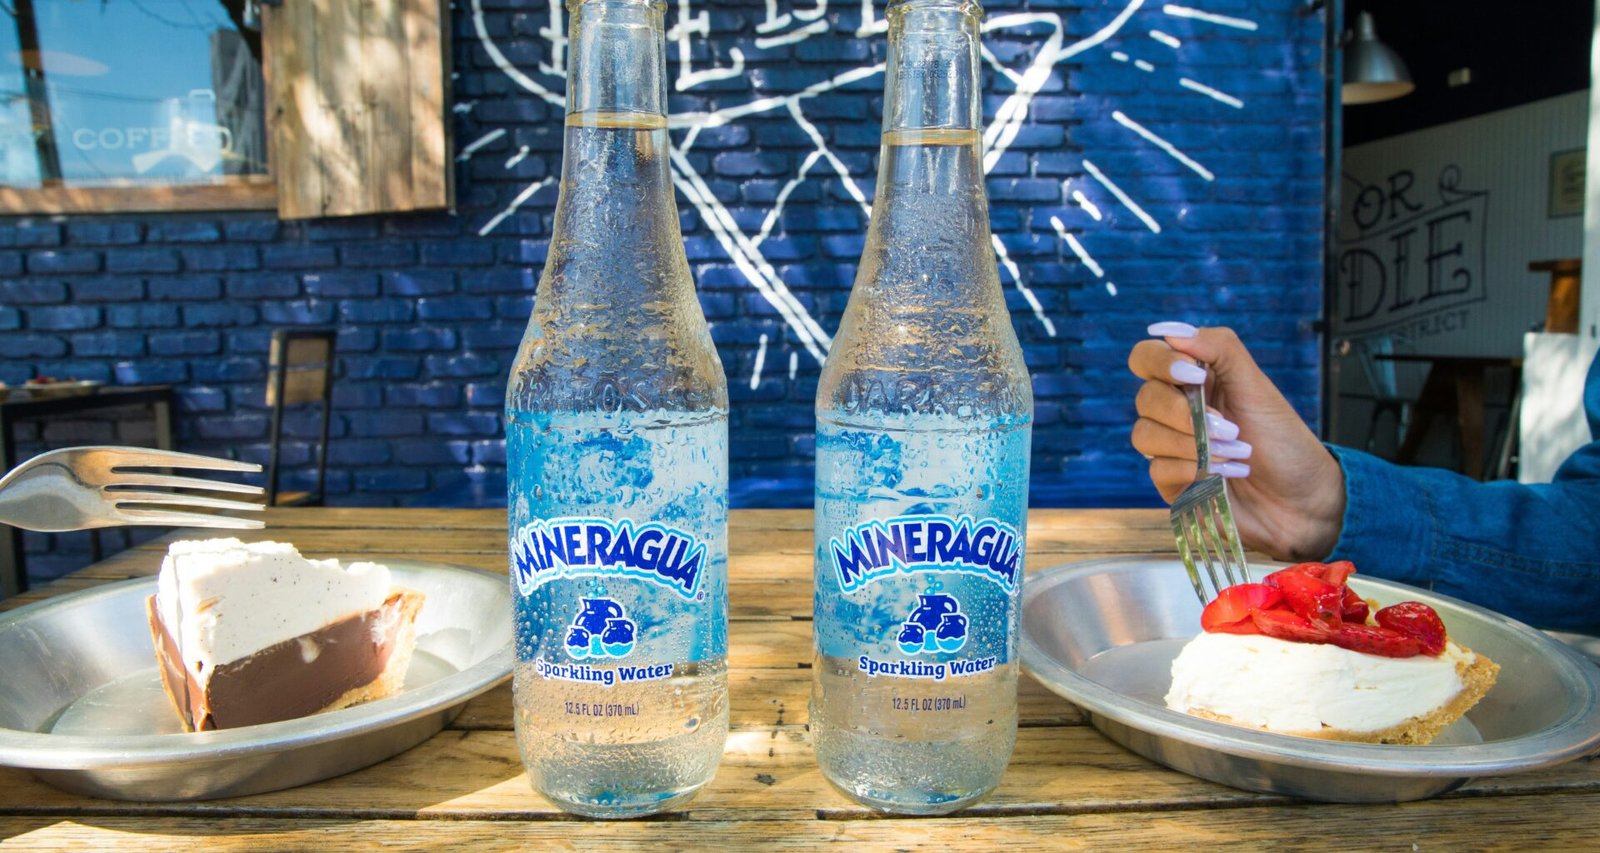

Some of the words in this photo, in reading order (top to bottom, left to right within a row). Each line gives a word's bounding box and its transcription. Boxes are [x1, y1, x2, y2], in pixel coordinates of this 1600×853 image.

[1353, 170, 1423, 229] OR
[1340, 210, 1471, 323] DIE
[513, 525, 702, 590] MINERAGUA
[834, 522, 1020, 585] MINERAGUA
[537, 659, 614, 685] Sparkling
[618, 664, 673, 680] Water
[859, 656, 945, 679] Sparkling
[950, 656, 995, 675] Water
[565, 702, 580, 715] 12.5
[582, 705, 591, 716] FL
[593, 705, 603, 716] OZ
[606, 704, 622, 717] (370
[624, 702, 640, 716] mL)
[892, 697, 908, 710] 12.5
[911, 698, 920, 711] FL
[922, 698, 932, 710] OZ
[934, 697, 951, 711] (370
[952, 695, 966, 709] mL)
